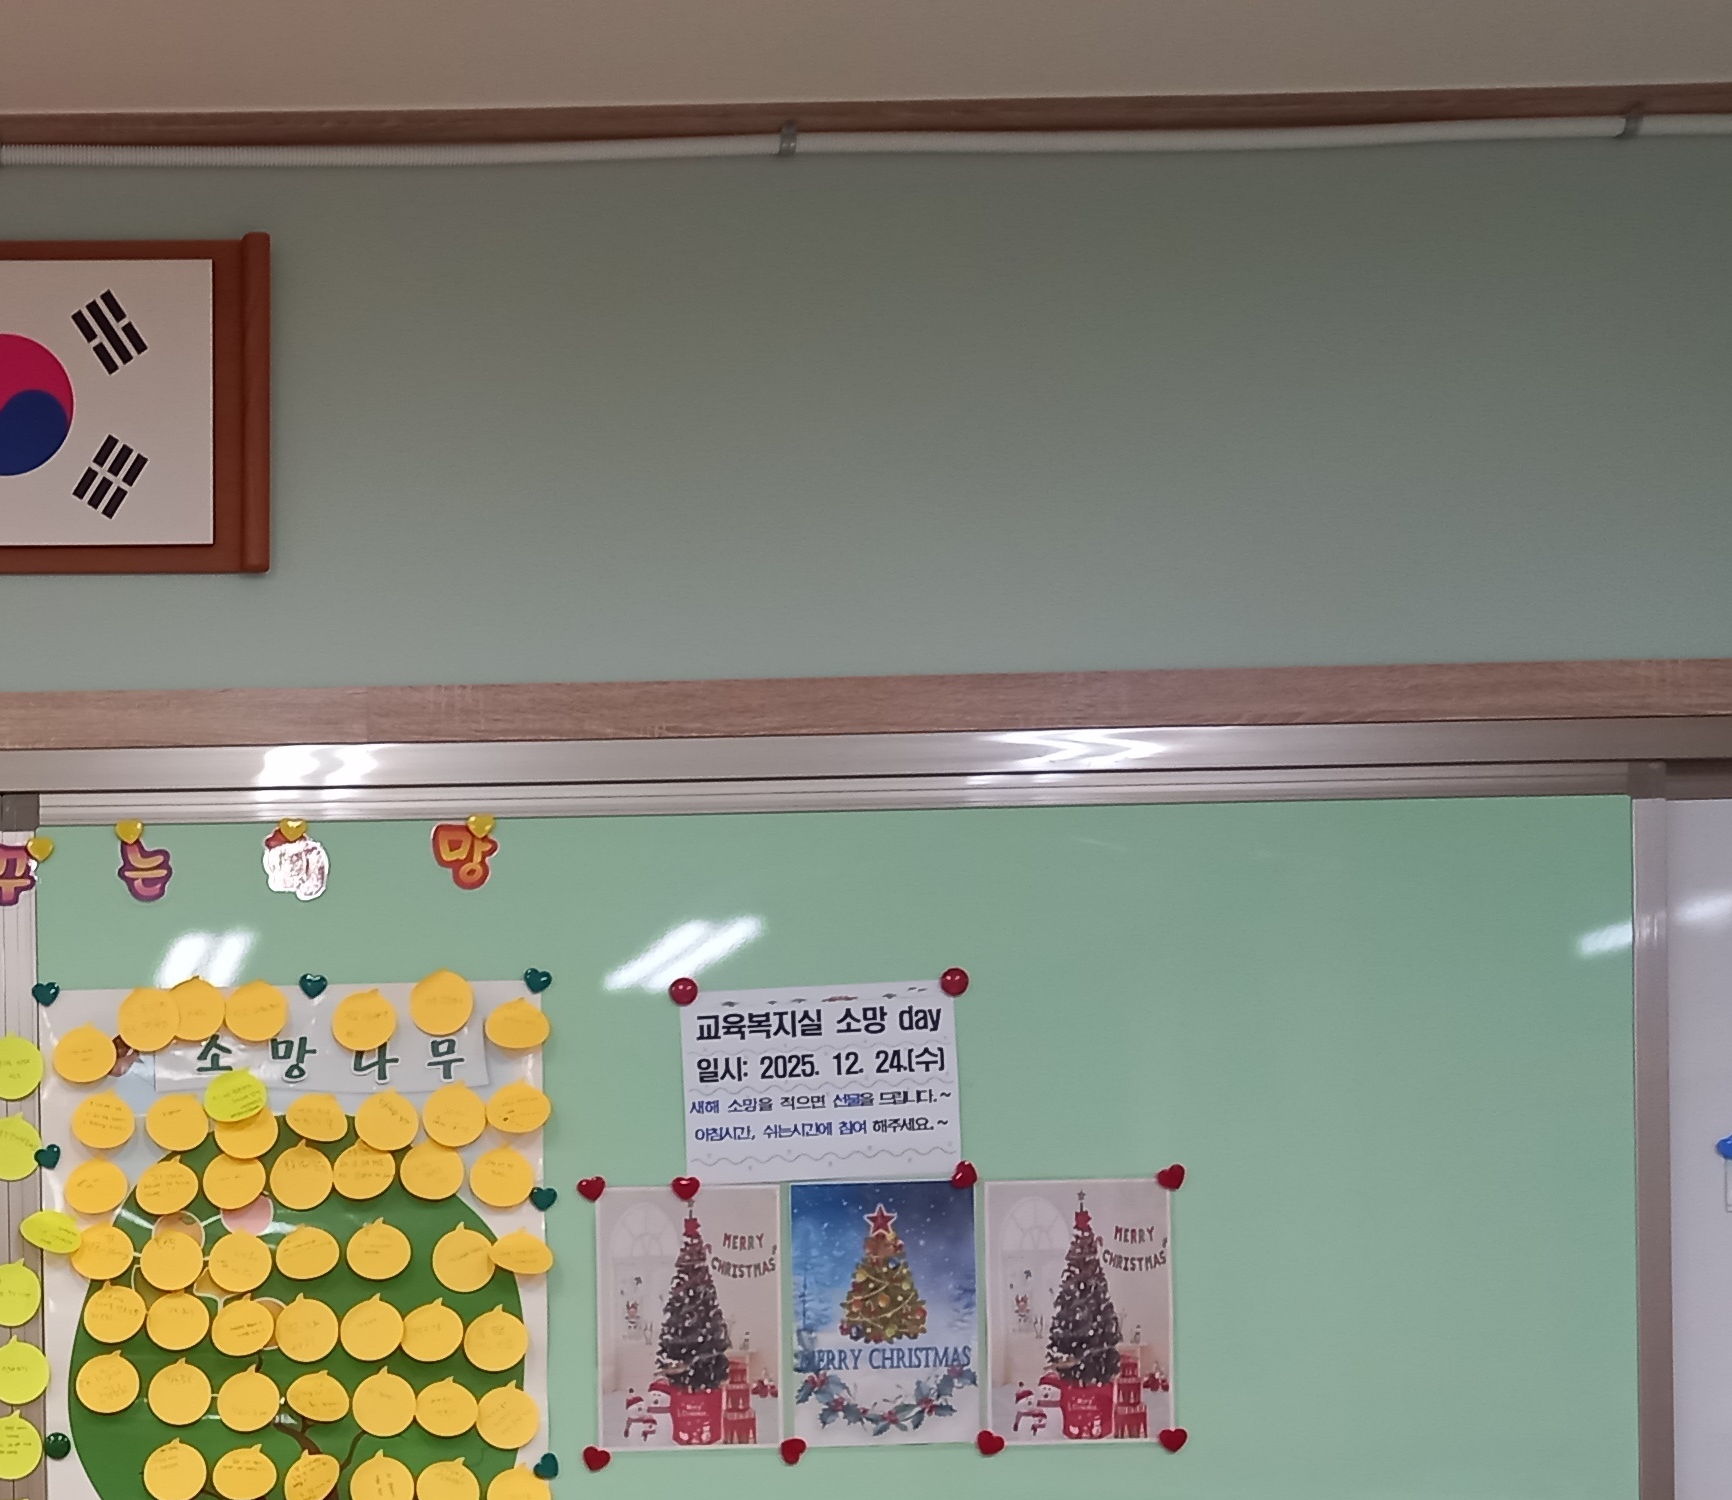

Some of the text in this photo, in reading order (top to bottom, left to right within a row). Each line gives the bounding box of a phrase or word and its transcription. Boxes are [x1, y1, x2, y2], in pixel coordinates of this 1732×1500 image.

[696, 1004, 942, 1041] 교육복지실 소망 day
[696, 1056, 749, 1083] 일시:
[759, 1054, 820, 1079] 2025.
[832, 1051, 864, 1076] 12.
[689, 1100, 719, 1115] 새해
[727, 1097, 773, 1113] 소망을
[780, 1095, 826, 1110] 적으면
[832, 1092, 874, 1108] 선물을
[722, 1232, 765, 1252] MERRY
[1113, 1225, 1155, 1245] MERRY
[711, 1256, 776, 1279] CHRISTMAS
[1102, 1248, 1167, 1272] CHRISTMAS
[868, 1346, 971, 1370] CHRISTMAS
